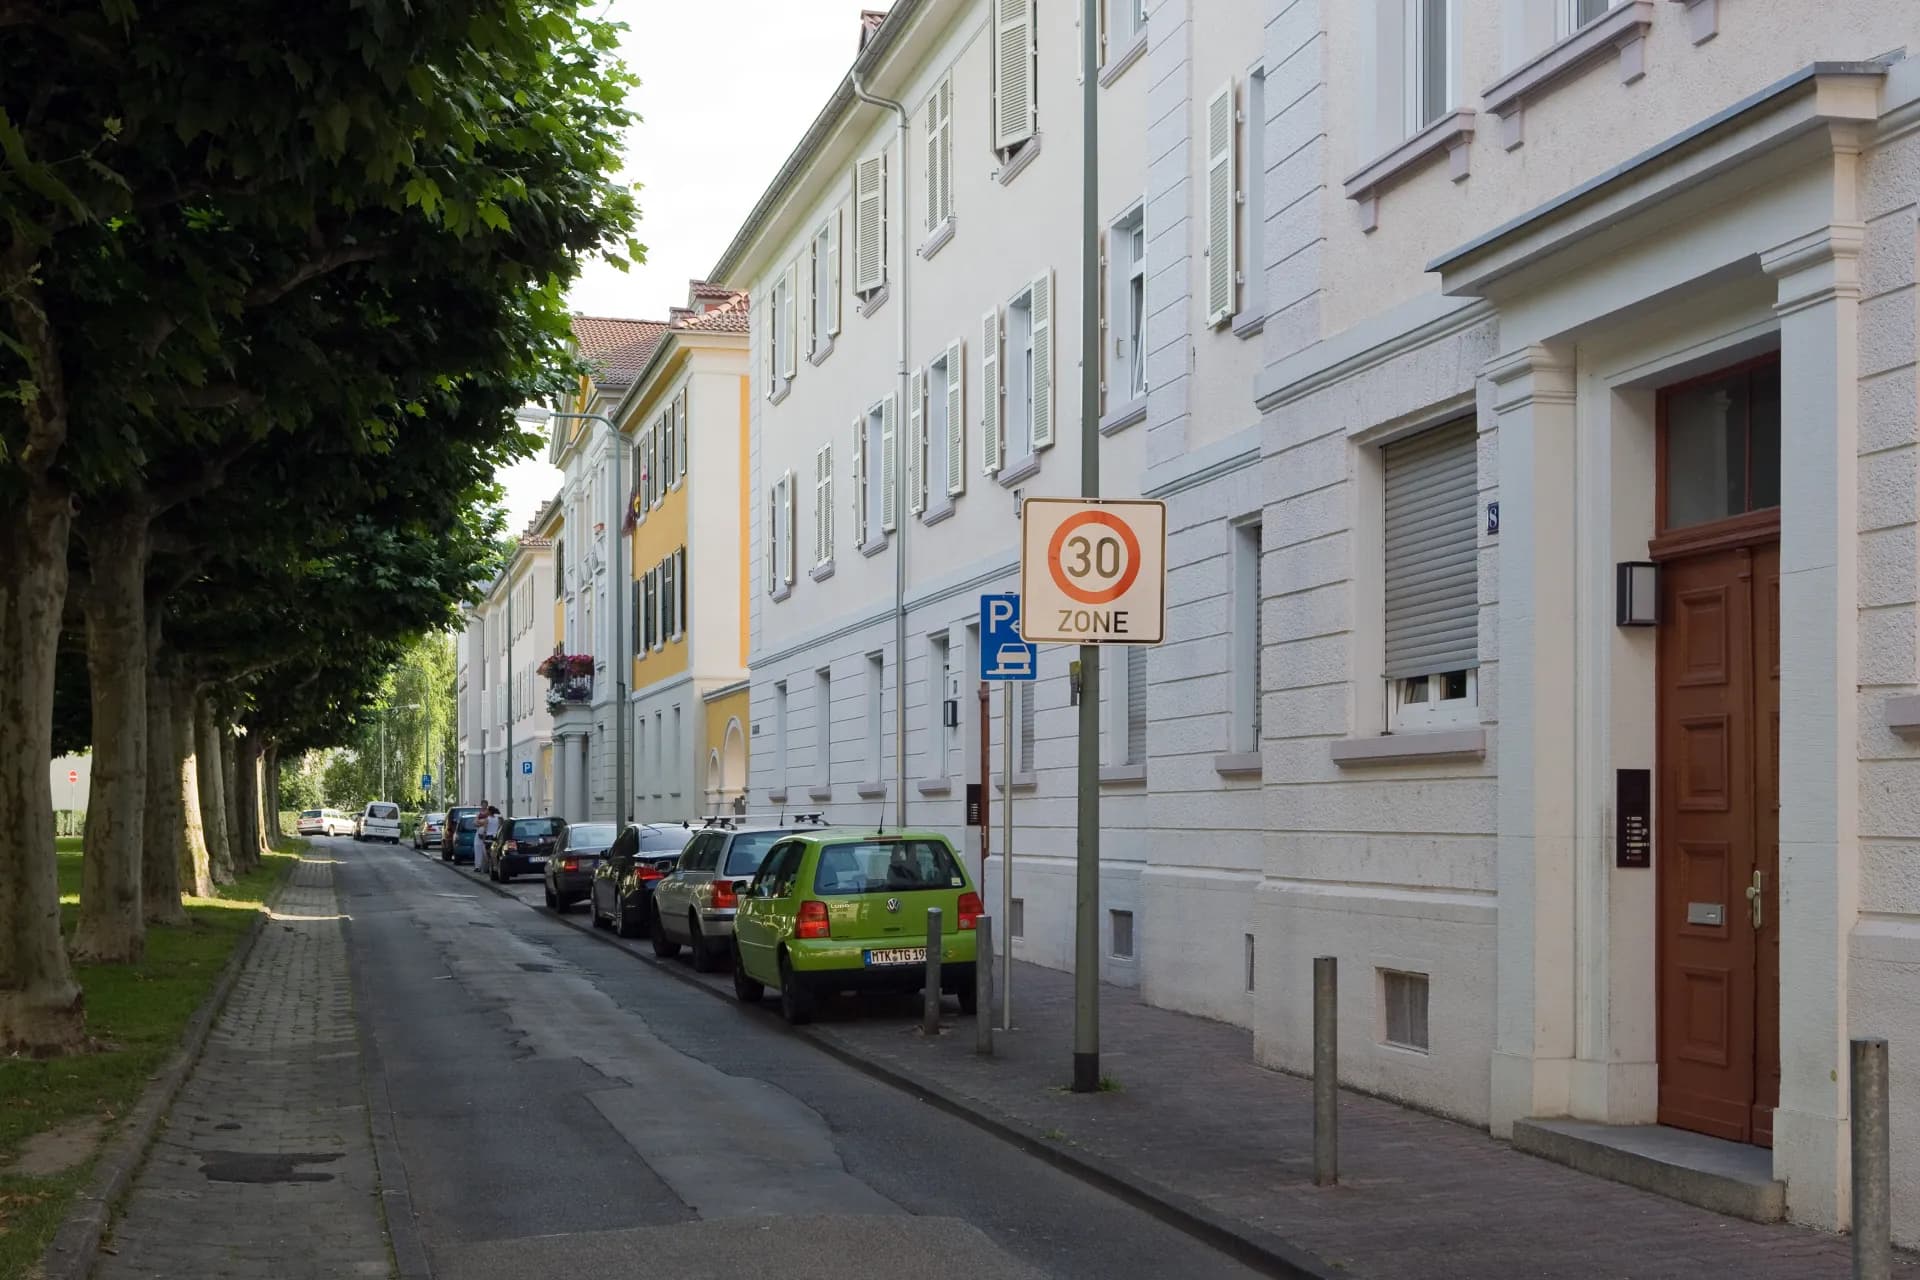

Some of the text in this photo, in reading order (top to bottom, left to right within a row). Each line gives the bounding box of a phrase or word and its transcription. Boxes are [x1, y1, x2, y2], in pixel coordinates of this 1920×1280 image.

[1489, 507, 1497, 528] 8
[1067, 536, 1120, 579] 30
[989, 600, 1014, 634] P
[1058, 610, 1129, 634] ZONE
[872, 951, 891, 962] MTK
[898, 949, 911, 961] TG
